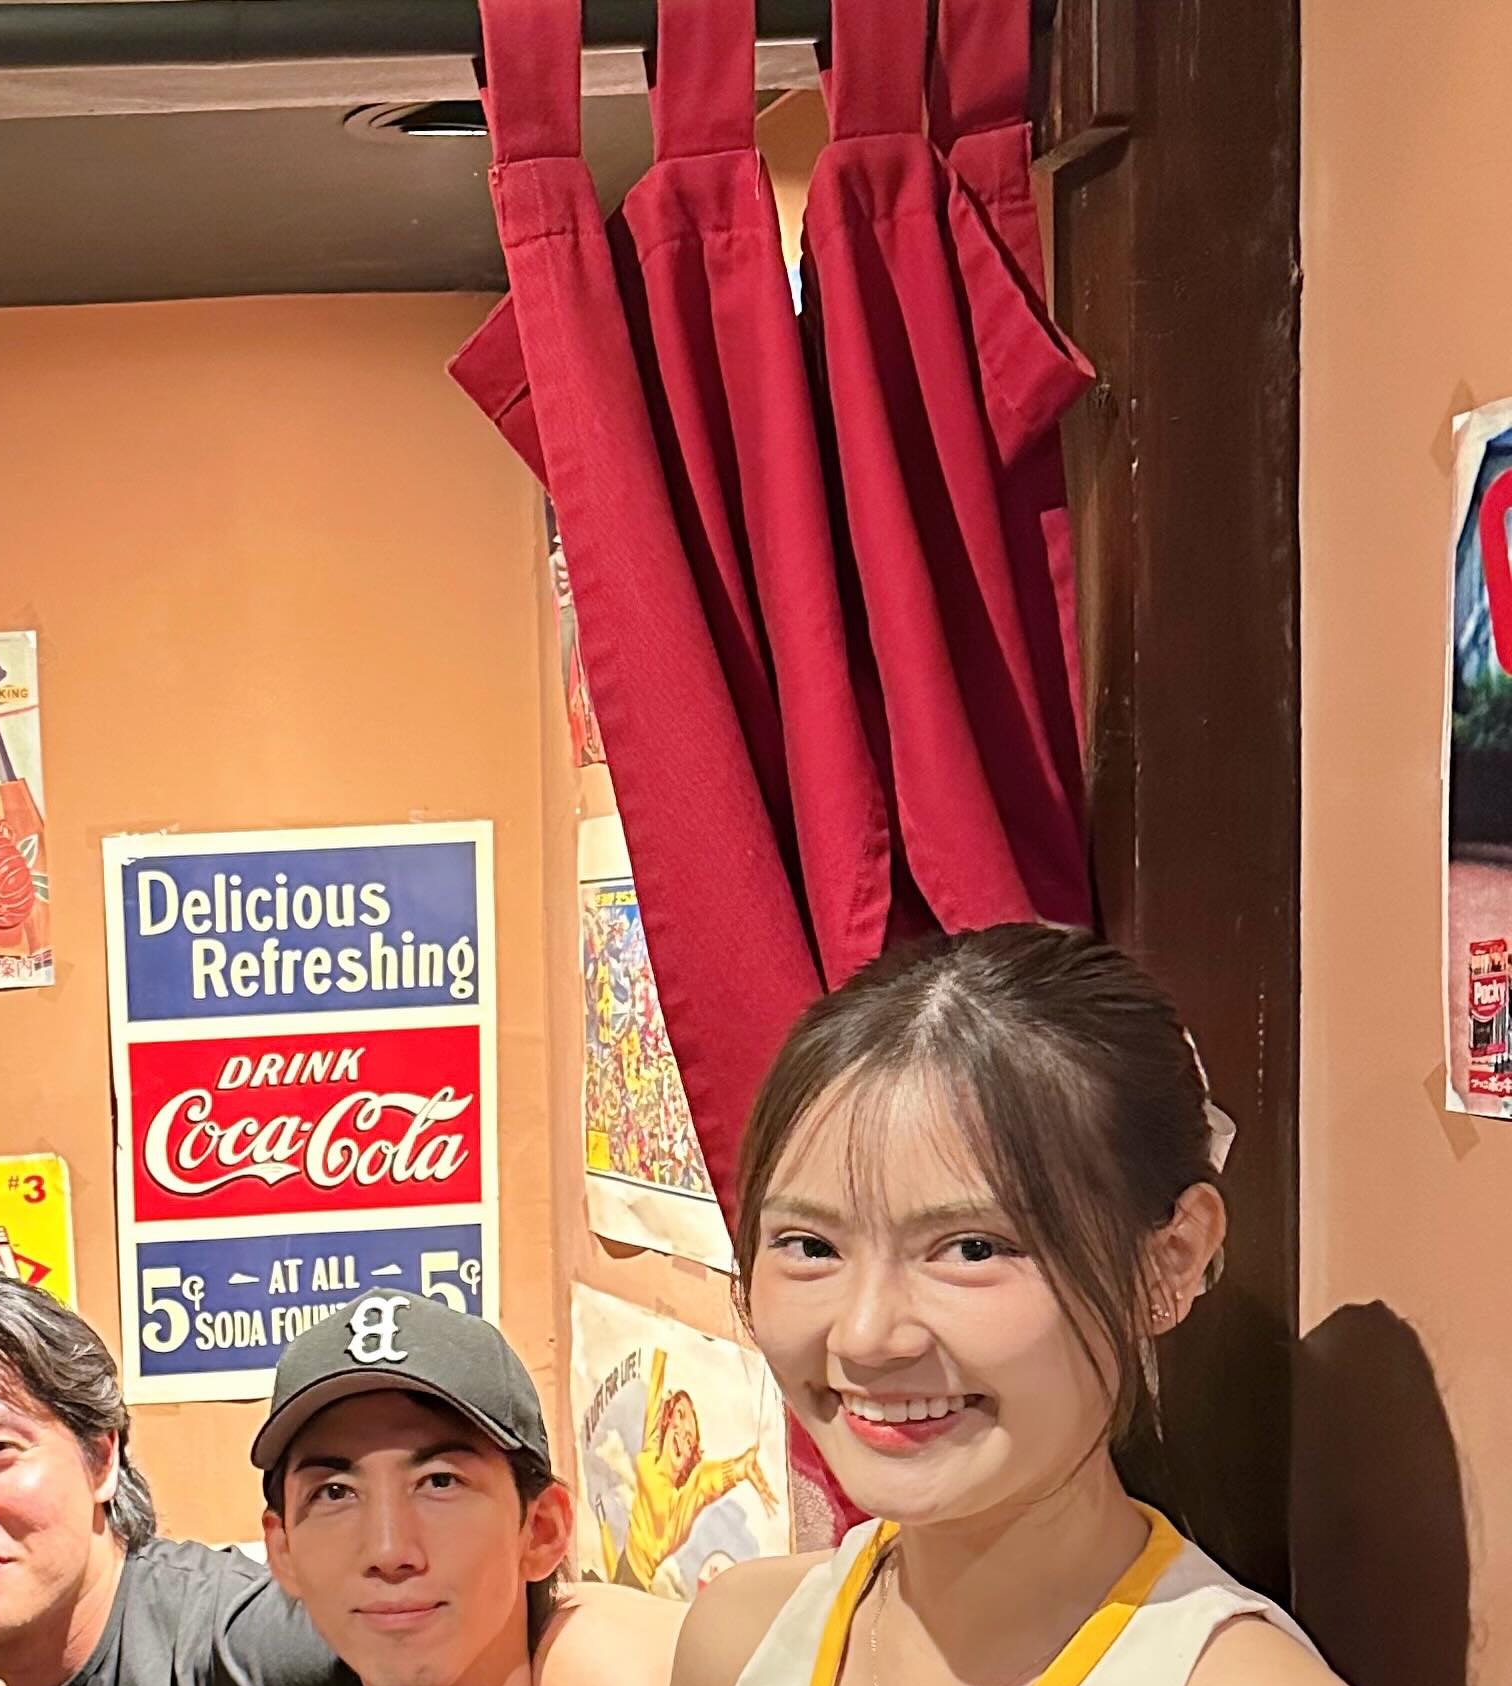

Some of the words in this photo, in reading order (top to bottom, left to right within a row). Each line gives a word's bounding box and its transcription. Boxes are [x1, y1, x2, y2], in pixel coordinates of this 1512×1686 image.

[137, 870, 391, 937] Delicious
[191, 930, 476, 1000] Refreshing
[215, 1047, 366, 1091] DRINK
[144, 1085, 474, 1198] Coca-Cola
[7, 1174, 47, 1204] #3
[267, 1258, 303, 1296] AT
[310, 1256, 360, 1293] ALL
[194, 1309, 267, 1350] SODA
